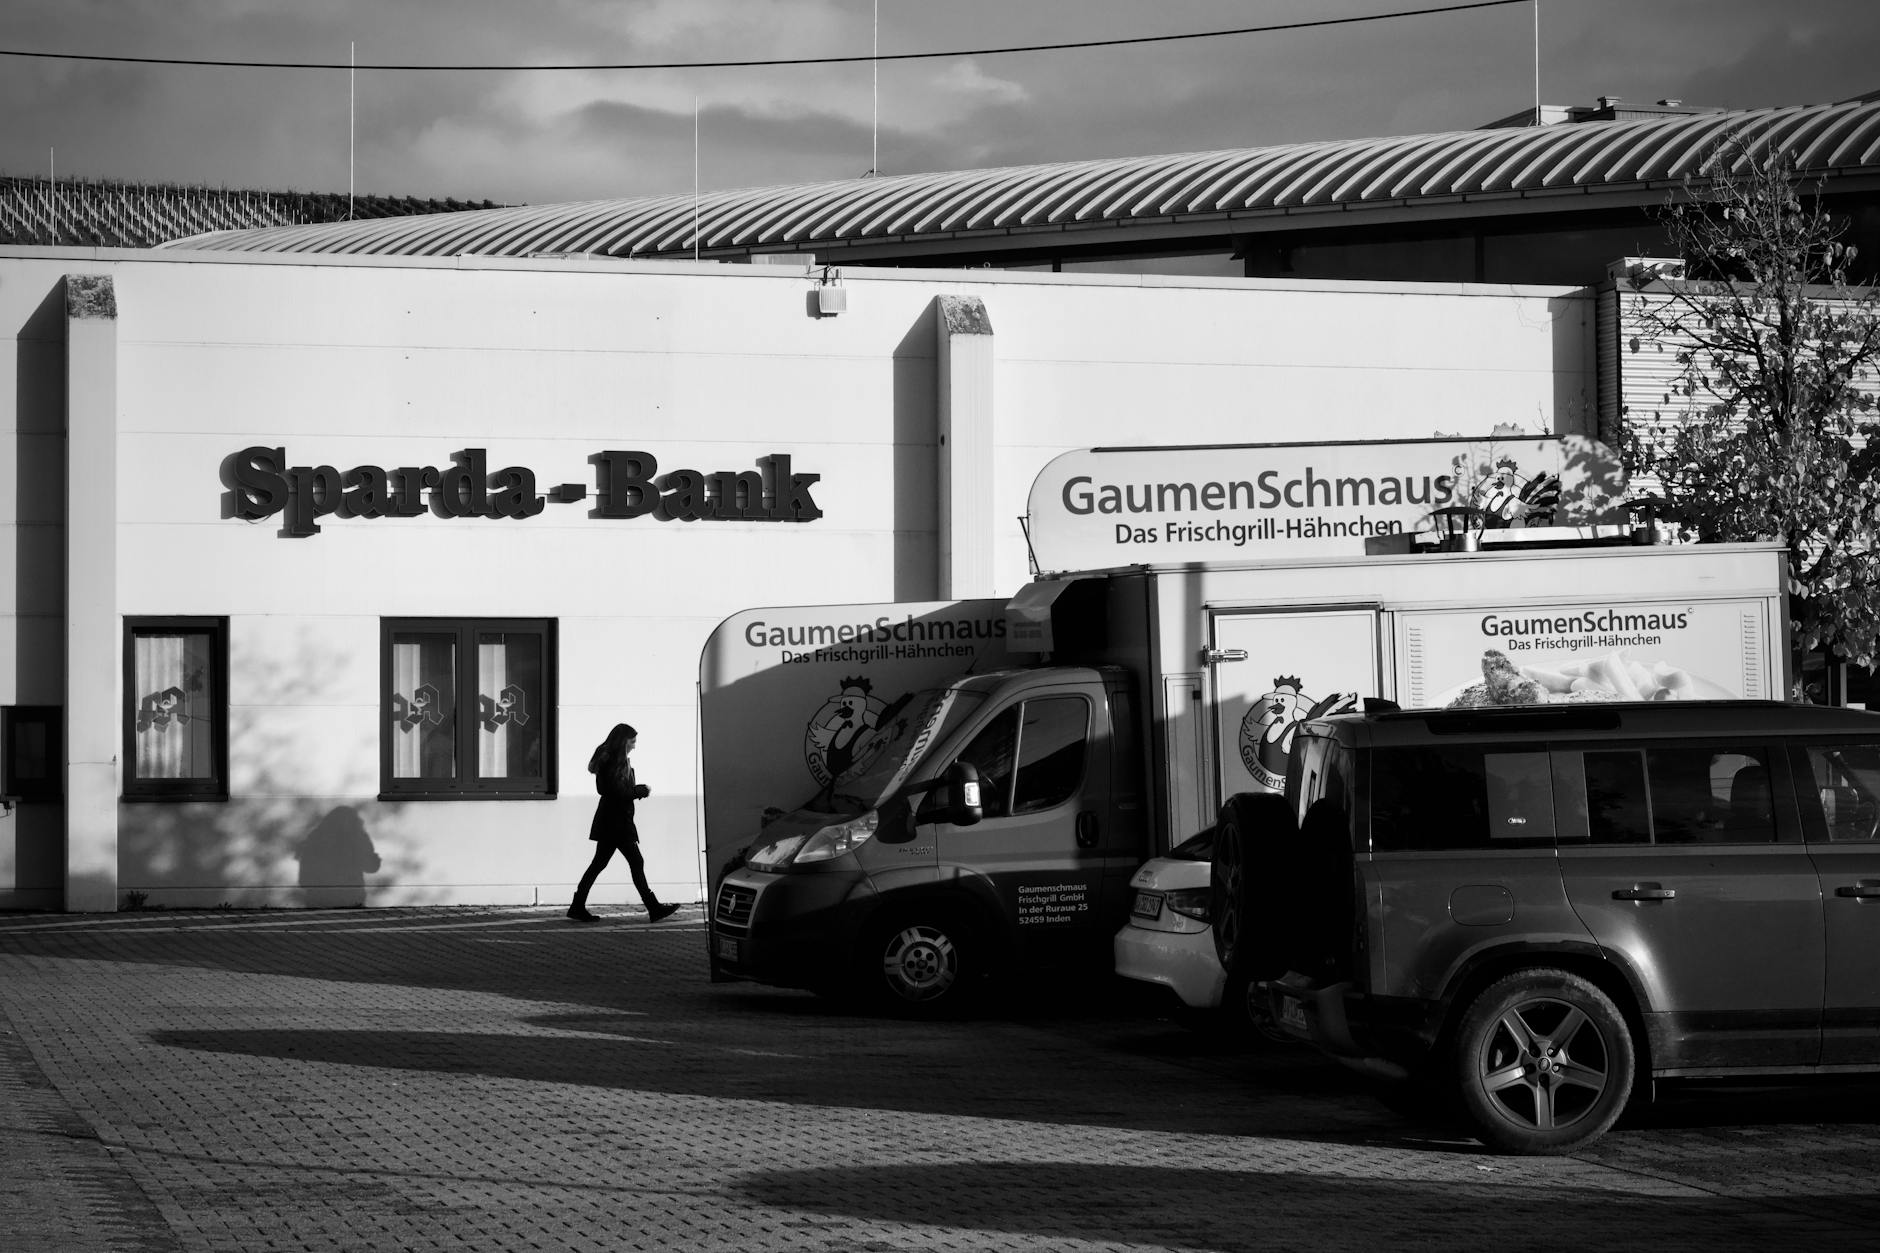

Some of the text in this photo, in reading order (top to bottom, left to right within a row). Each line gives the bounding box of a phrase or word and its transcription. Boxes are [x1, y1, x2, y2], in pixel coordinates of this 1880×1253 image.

[1115, 515, 1403, 546] Das Frischgrill-Hähnchen
[745, 614, 1007, 647] GaumenSchmaus
[1508, 634, 1661, 651] Das Frischgrill-Hähnchen
[782, 643, 975, 665] Das Frischgrill-Hähnchen
[1018, 884, 1088, 894] Gaumenschmaus
[1018, 893, 1085, 905] Frischgrill GmbH
[1019, 903, 1089, 914] In der Ruraue 25
[1019, 914, 1072, 925] 52459 Inden
